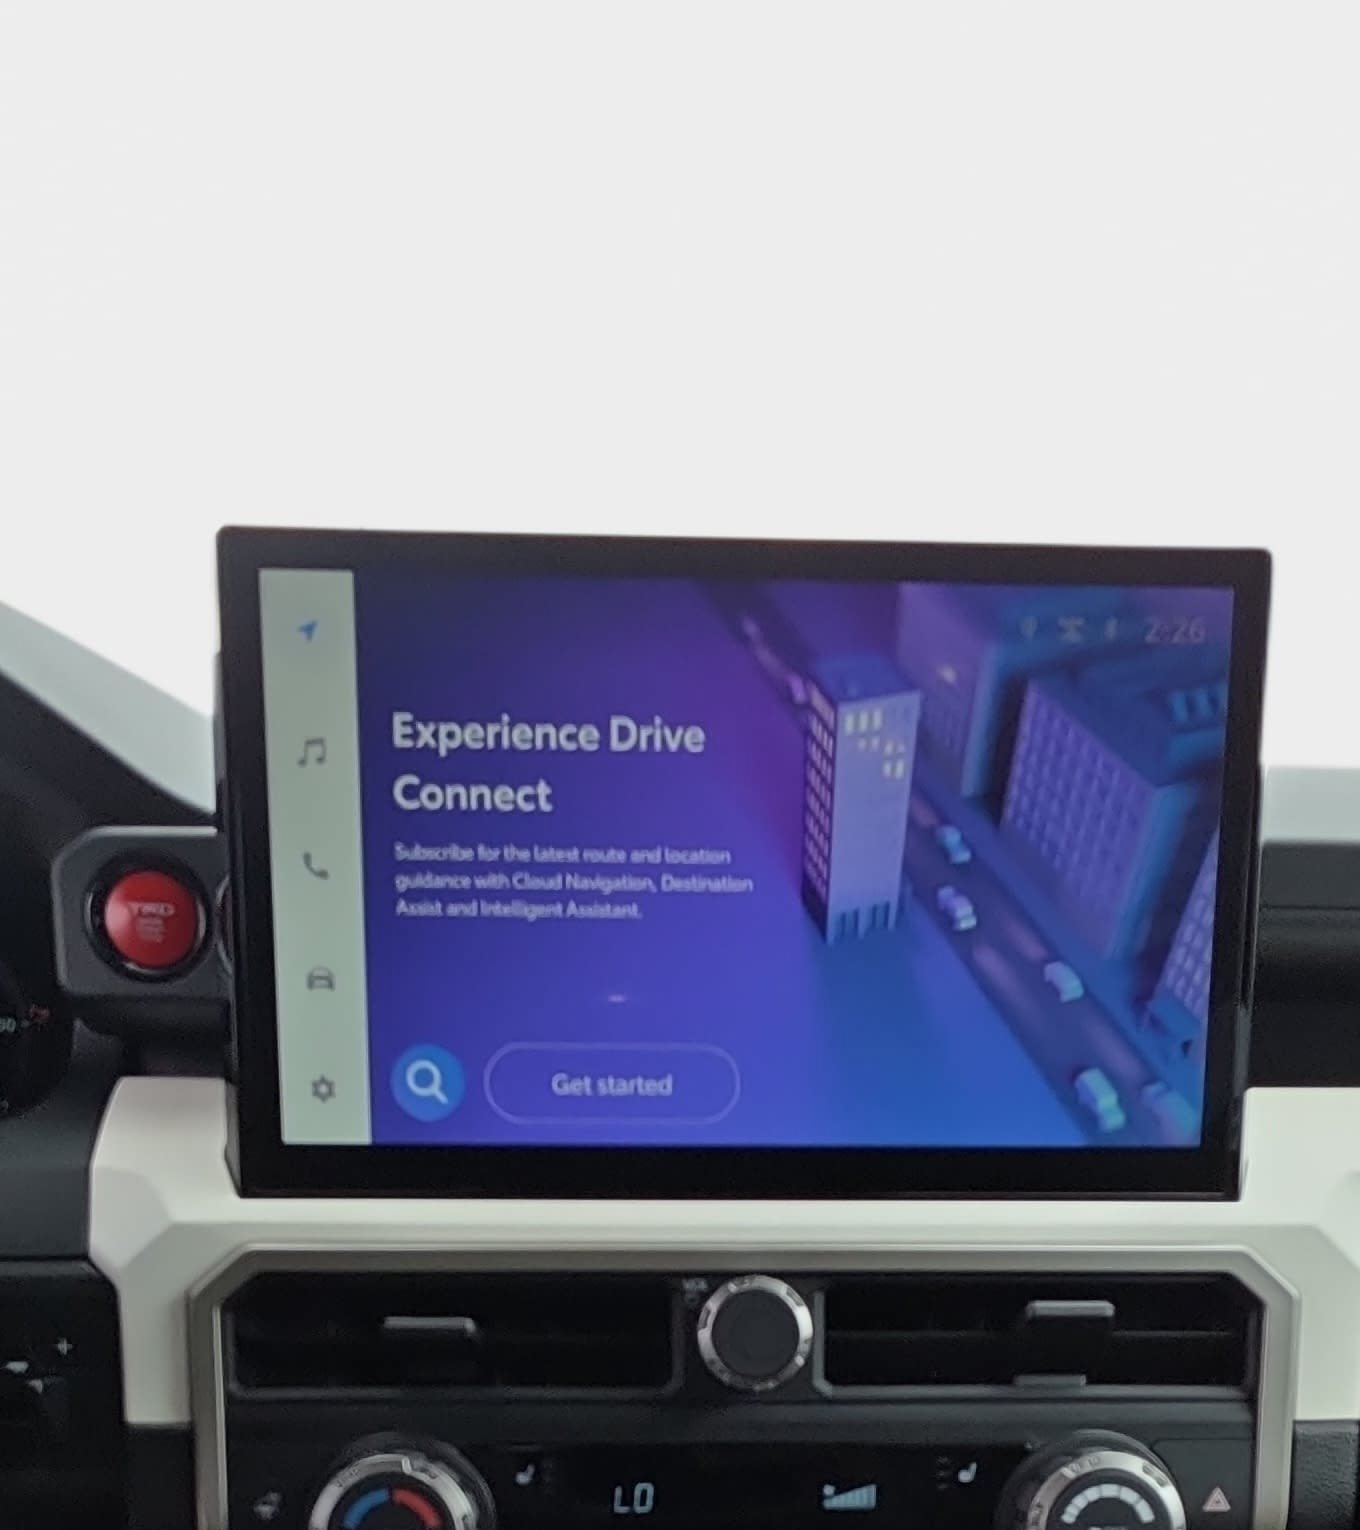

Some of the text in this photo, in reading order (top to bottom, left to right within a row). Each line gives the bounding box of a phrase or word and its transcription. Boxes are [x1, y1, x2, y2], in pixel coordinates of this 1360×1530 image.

[1144, 616, 1207, 643] 2:26
[392, 711, 706, 757] Experience Drive
[392, 774, 553, 812] Connect
[394, 841, 732, 865] Subscribe for the latest route and location
[395, 871, 755, 895] guidance with Cloud Navigation, Destination
[395, 898, 643, 922] Assist and Intelligent Assistant.
[551, 1072, 674, 1097] Get started
[613, 1482, 654, 1514] LO
